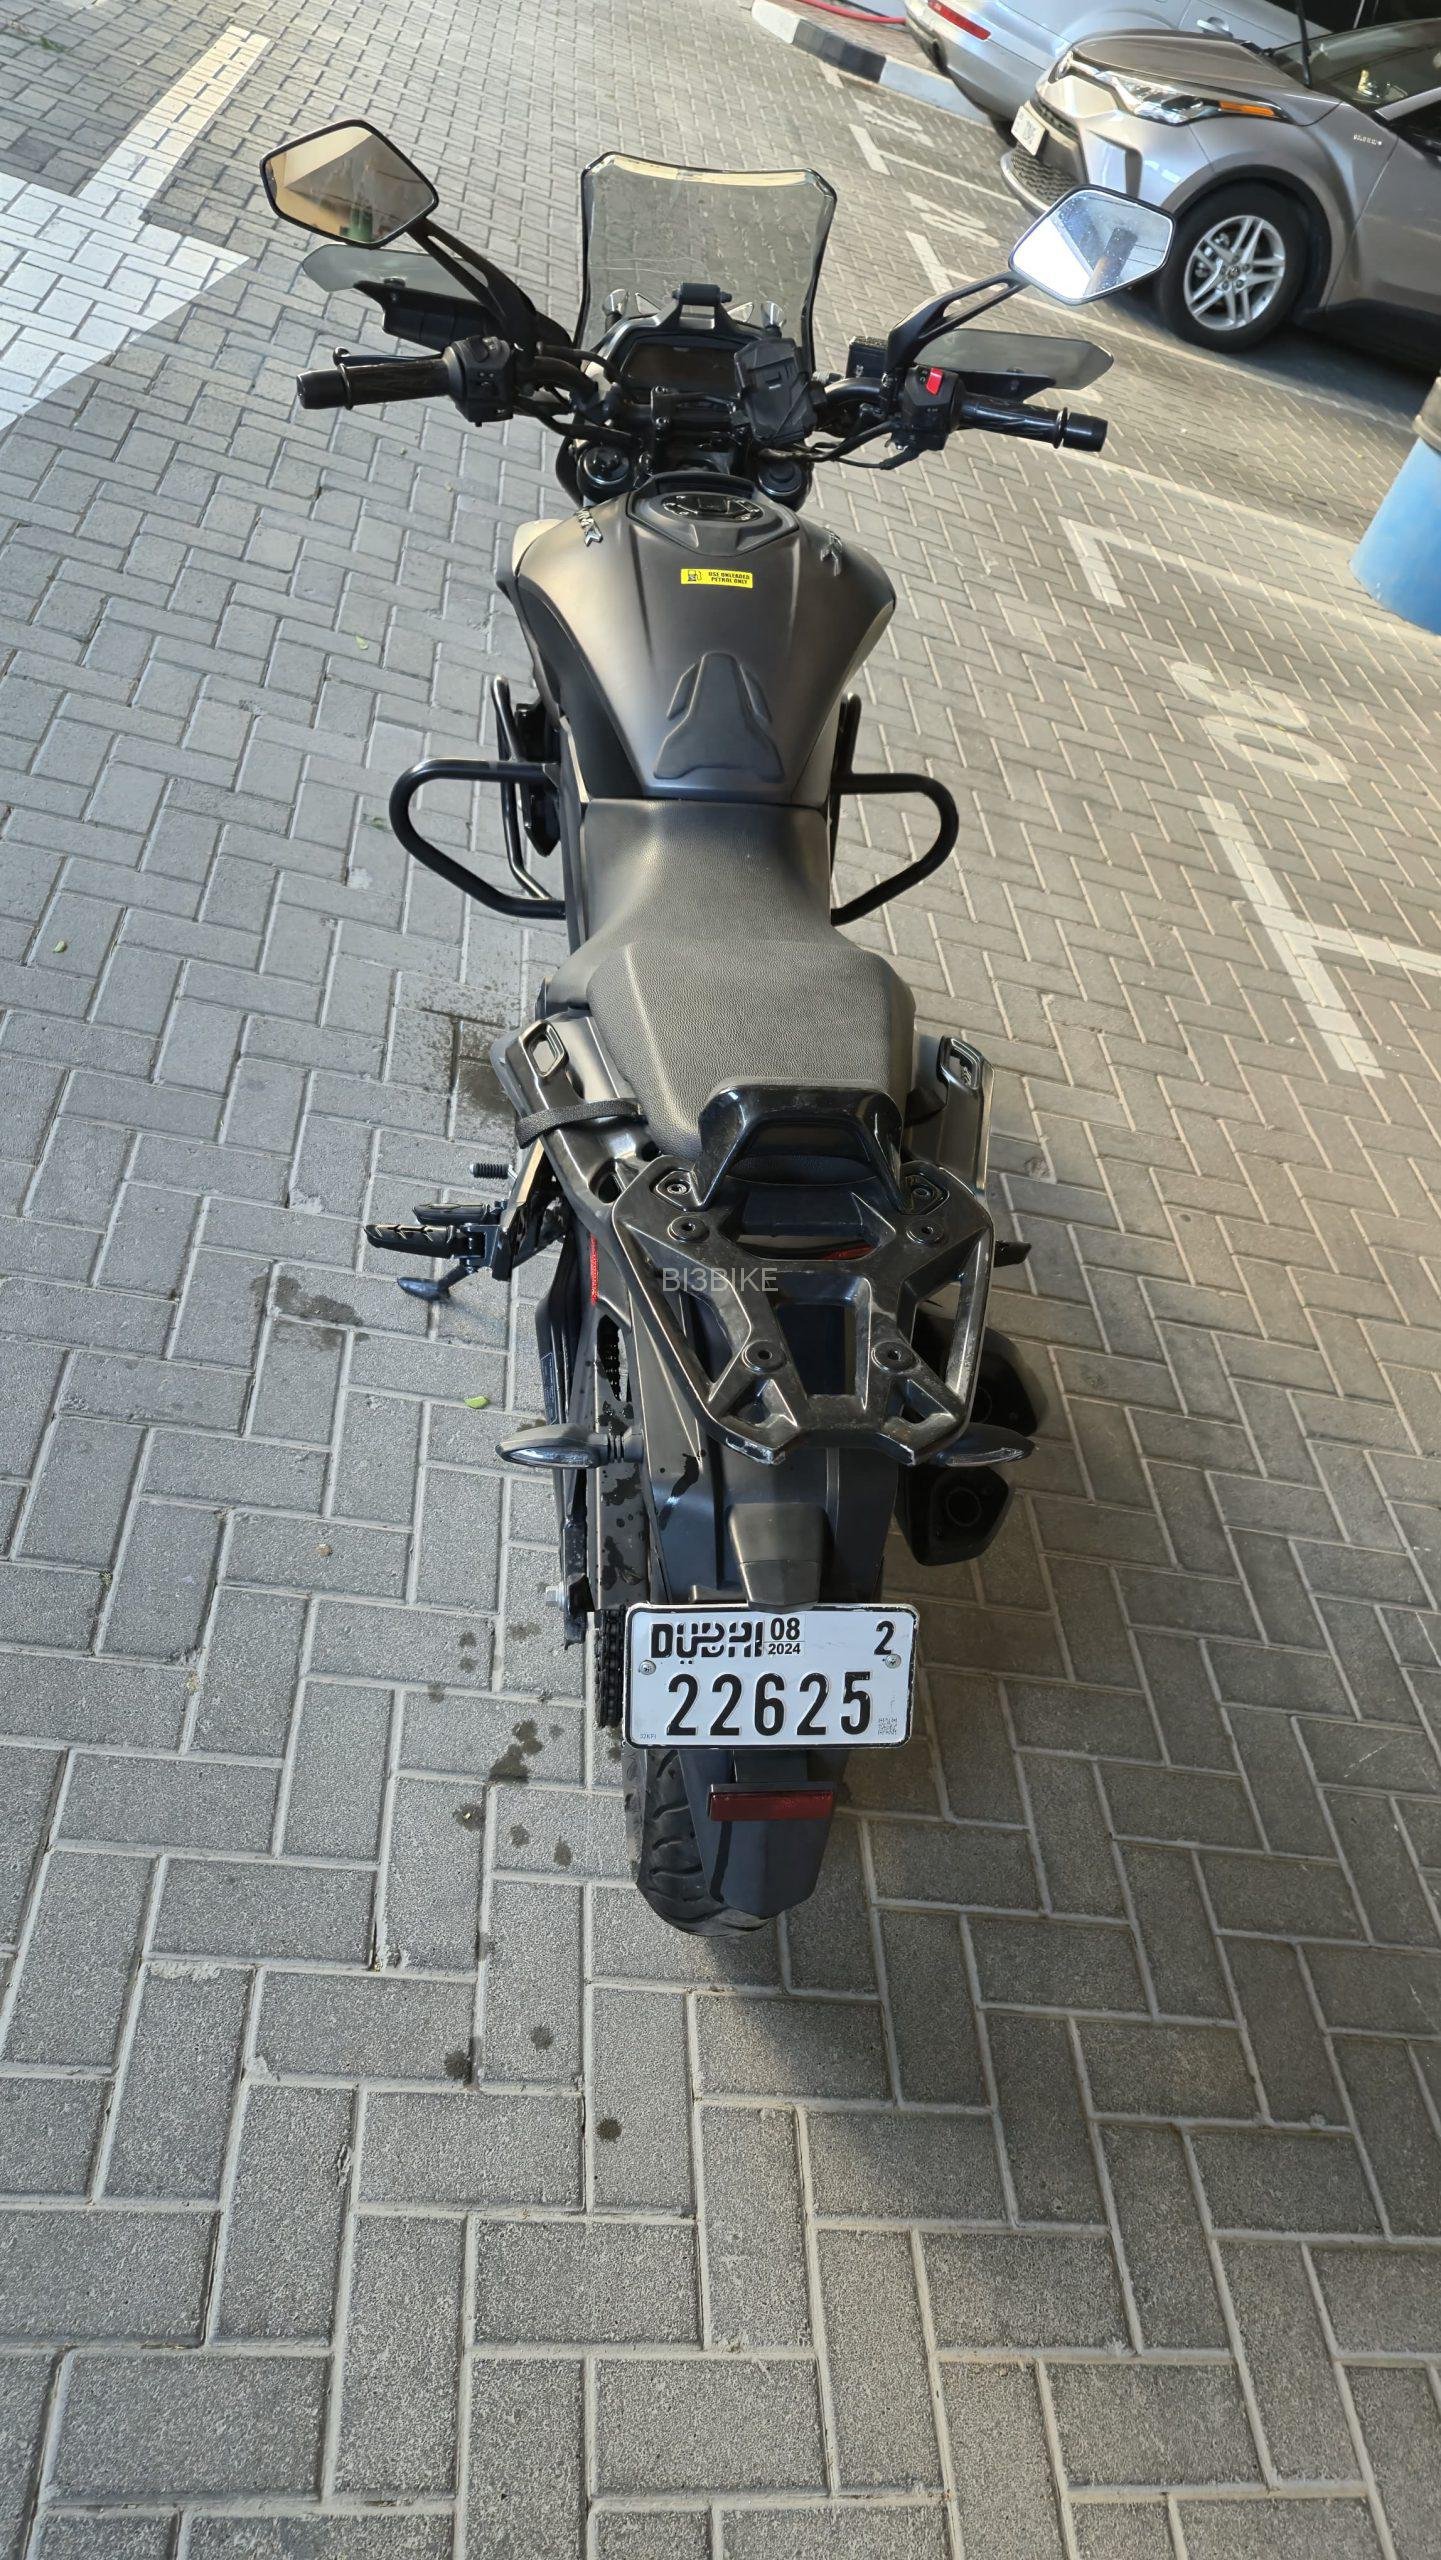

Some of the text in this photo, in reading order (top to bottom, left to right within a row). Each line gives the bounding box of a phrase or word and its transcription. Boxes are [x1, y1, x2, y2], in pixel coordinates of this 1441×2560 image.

[1169, 660, 1352, 785] 30
[770, 1617, 801, 1640] 08
[874, 1620, 896, 1655] 2
[767, 1642, 801, 1655] 2024
[666, 1670, 872, 1736] 22625
